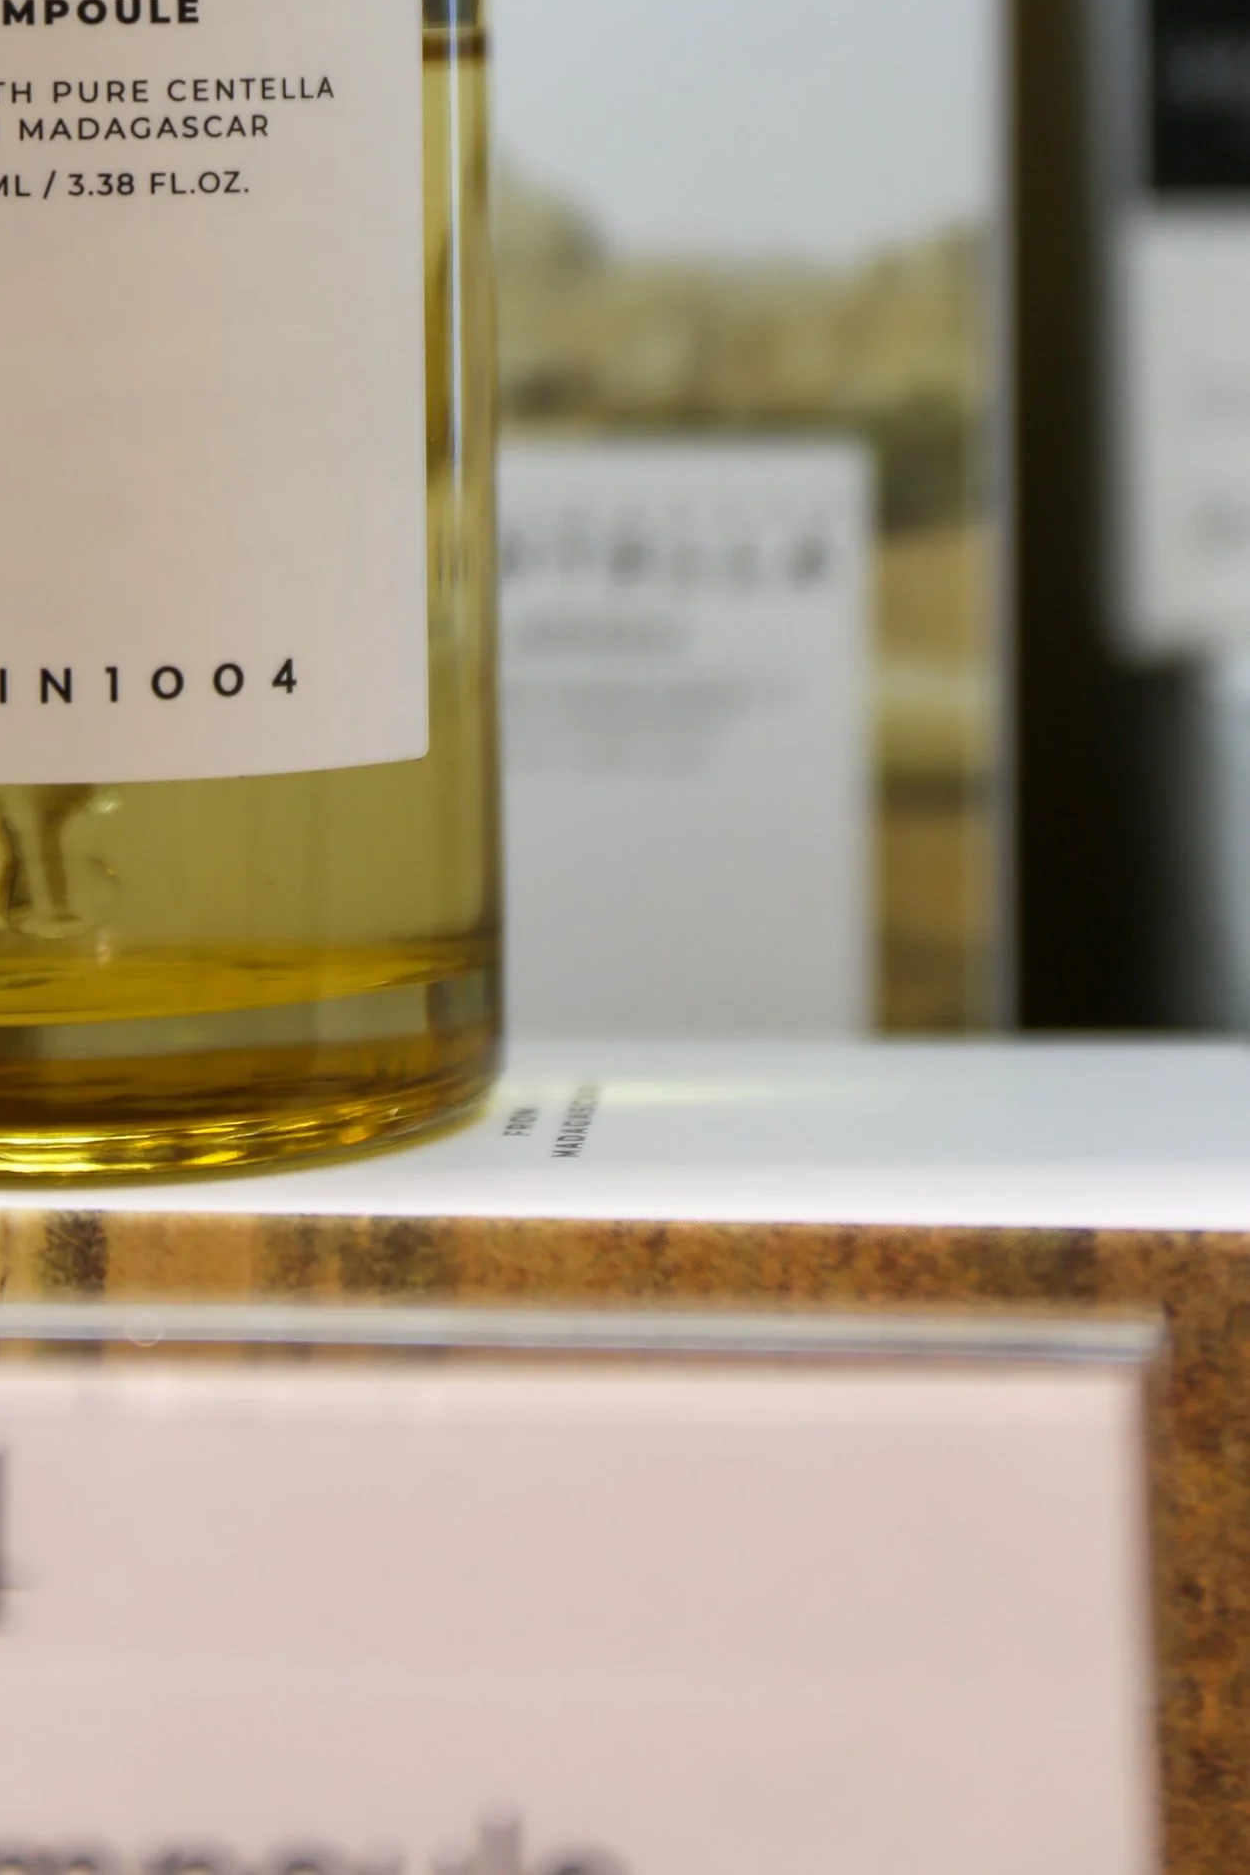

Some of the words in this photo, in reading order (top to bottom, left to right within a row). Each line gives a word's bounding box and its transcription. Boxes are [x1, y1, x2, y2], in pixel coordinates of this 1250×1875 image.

[52, 79, 150, 105] PURE
[166, 76, 335, 103] CENTELLA
[18, 113, 269, 142] MADAGASCAR
[42, 169, 57, 200] /
[67, 172, 136, 197] 3.38
[149, 170, 250, 196] FL.OZ.
